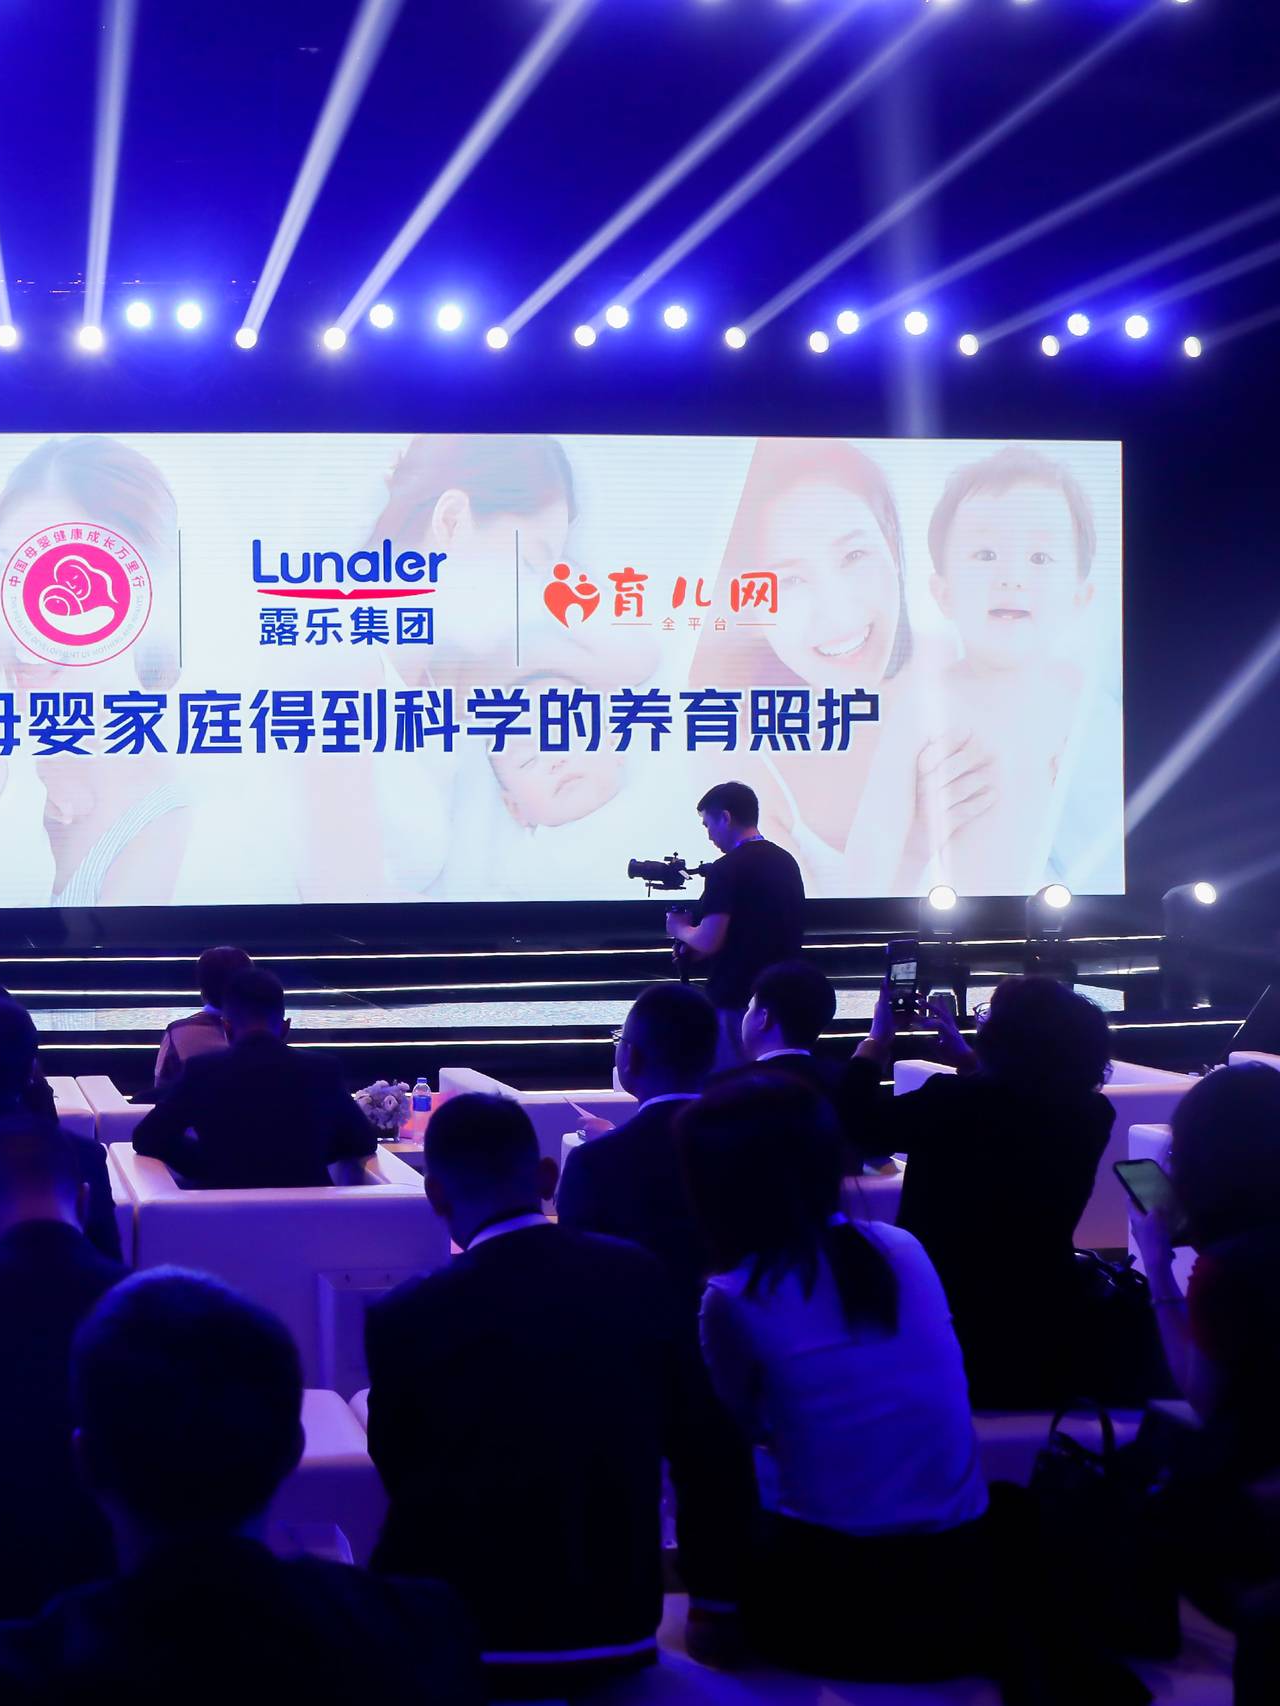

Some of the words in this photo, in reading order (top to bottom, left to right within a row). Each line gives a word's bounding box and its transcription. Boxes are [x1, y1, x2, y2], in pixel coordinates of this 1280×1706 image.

[8, 528, 145, 588] 中国母婴健康成长万里行
[252, 539, 447, 584] Lunaler
[607, 567, 778, 617] 育儿网
[259, 606, 435, 646] 露乐集团
[661, 617, 727, 631] 全平台
